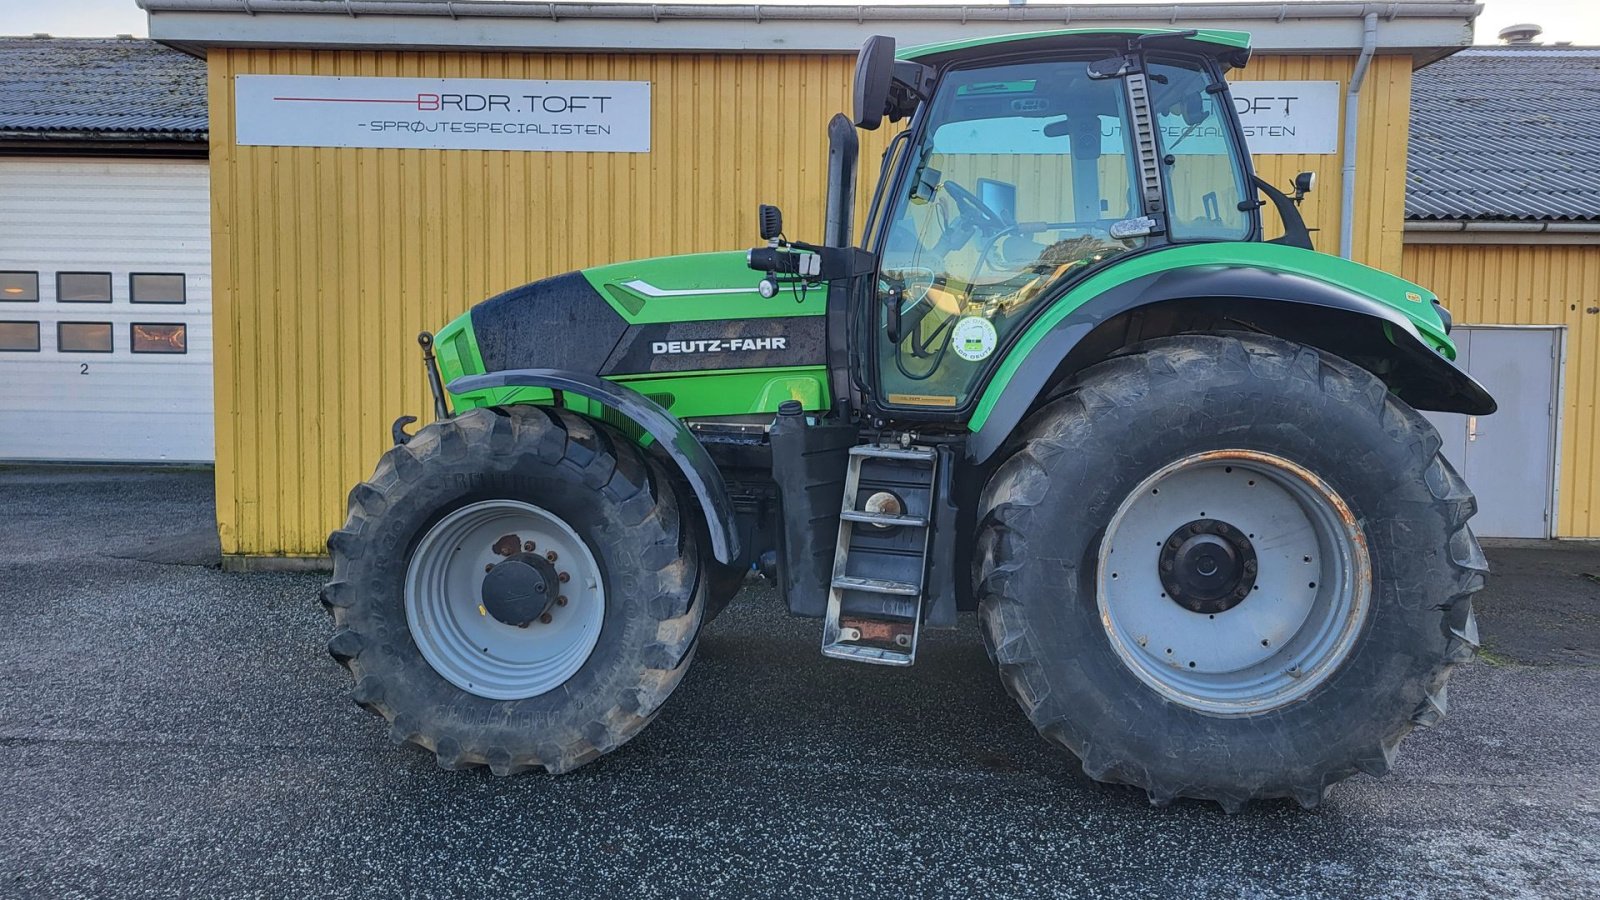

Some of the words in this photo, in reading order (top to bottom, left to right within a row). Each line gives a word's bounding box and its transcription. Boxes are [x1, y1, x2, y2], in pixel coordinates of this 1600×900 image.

[417, 93, 612, 114] BRDR.TOFT
[652, 337, 786, 354] DEUTZ-FAHR
[80, 363, 89, 375] 2
